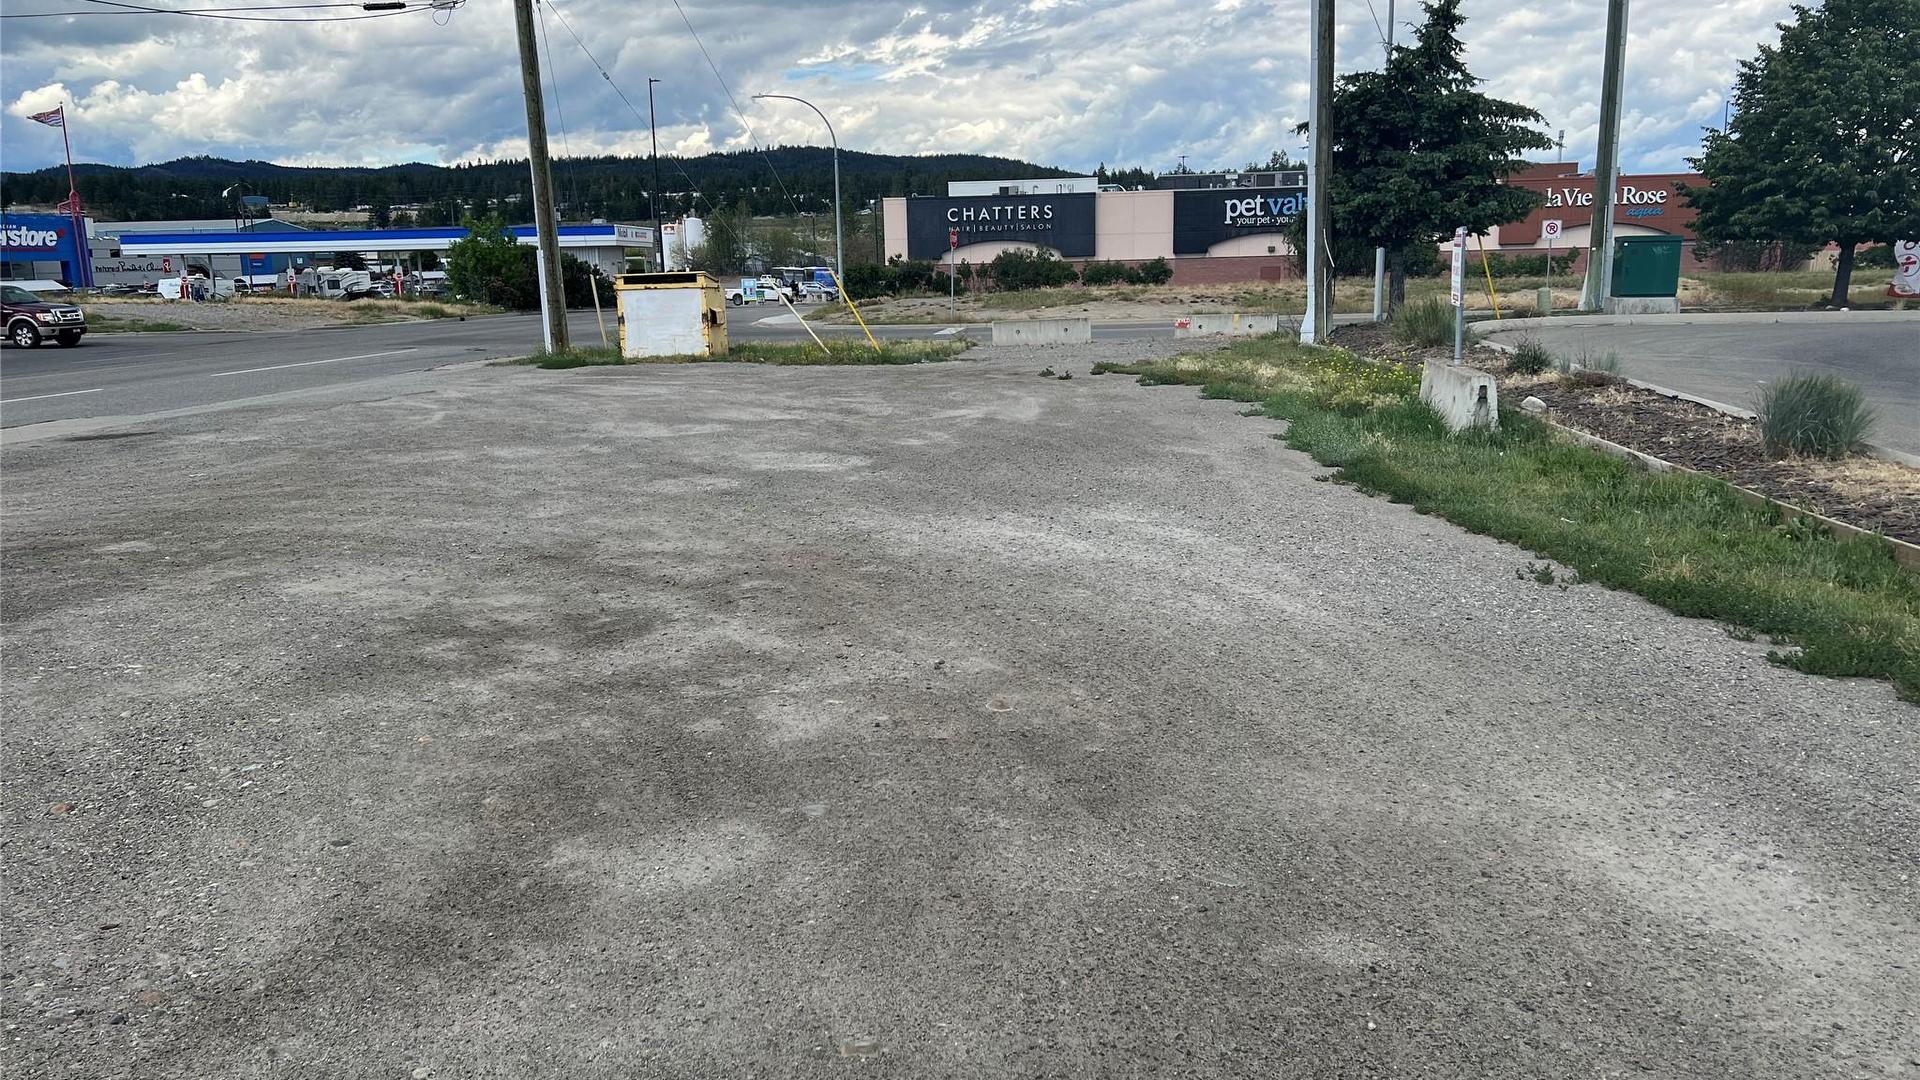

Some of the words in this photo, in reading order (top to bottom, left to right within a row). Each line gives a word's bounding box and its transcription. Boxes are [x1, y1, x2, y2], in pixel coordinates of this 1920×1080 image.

[1562, 187, 1593, 206] Vie
[1622, 186, 1667, 204] Rose
[947, 205, 1053, 222] CHATTERS
[1224, 195, 1265, 224] pet
[1267, 192, 1308, 215] val
[980, 224, 1014, 232] BEAUTY
[1236, 217, 1257, 227] your
[1257, 216, 1270, 226] pet
[0, 226, 58, 247] rstore
